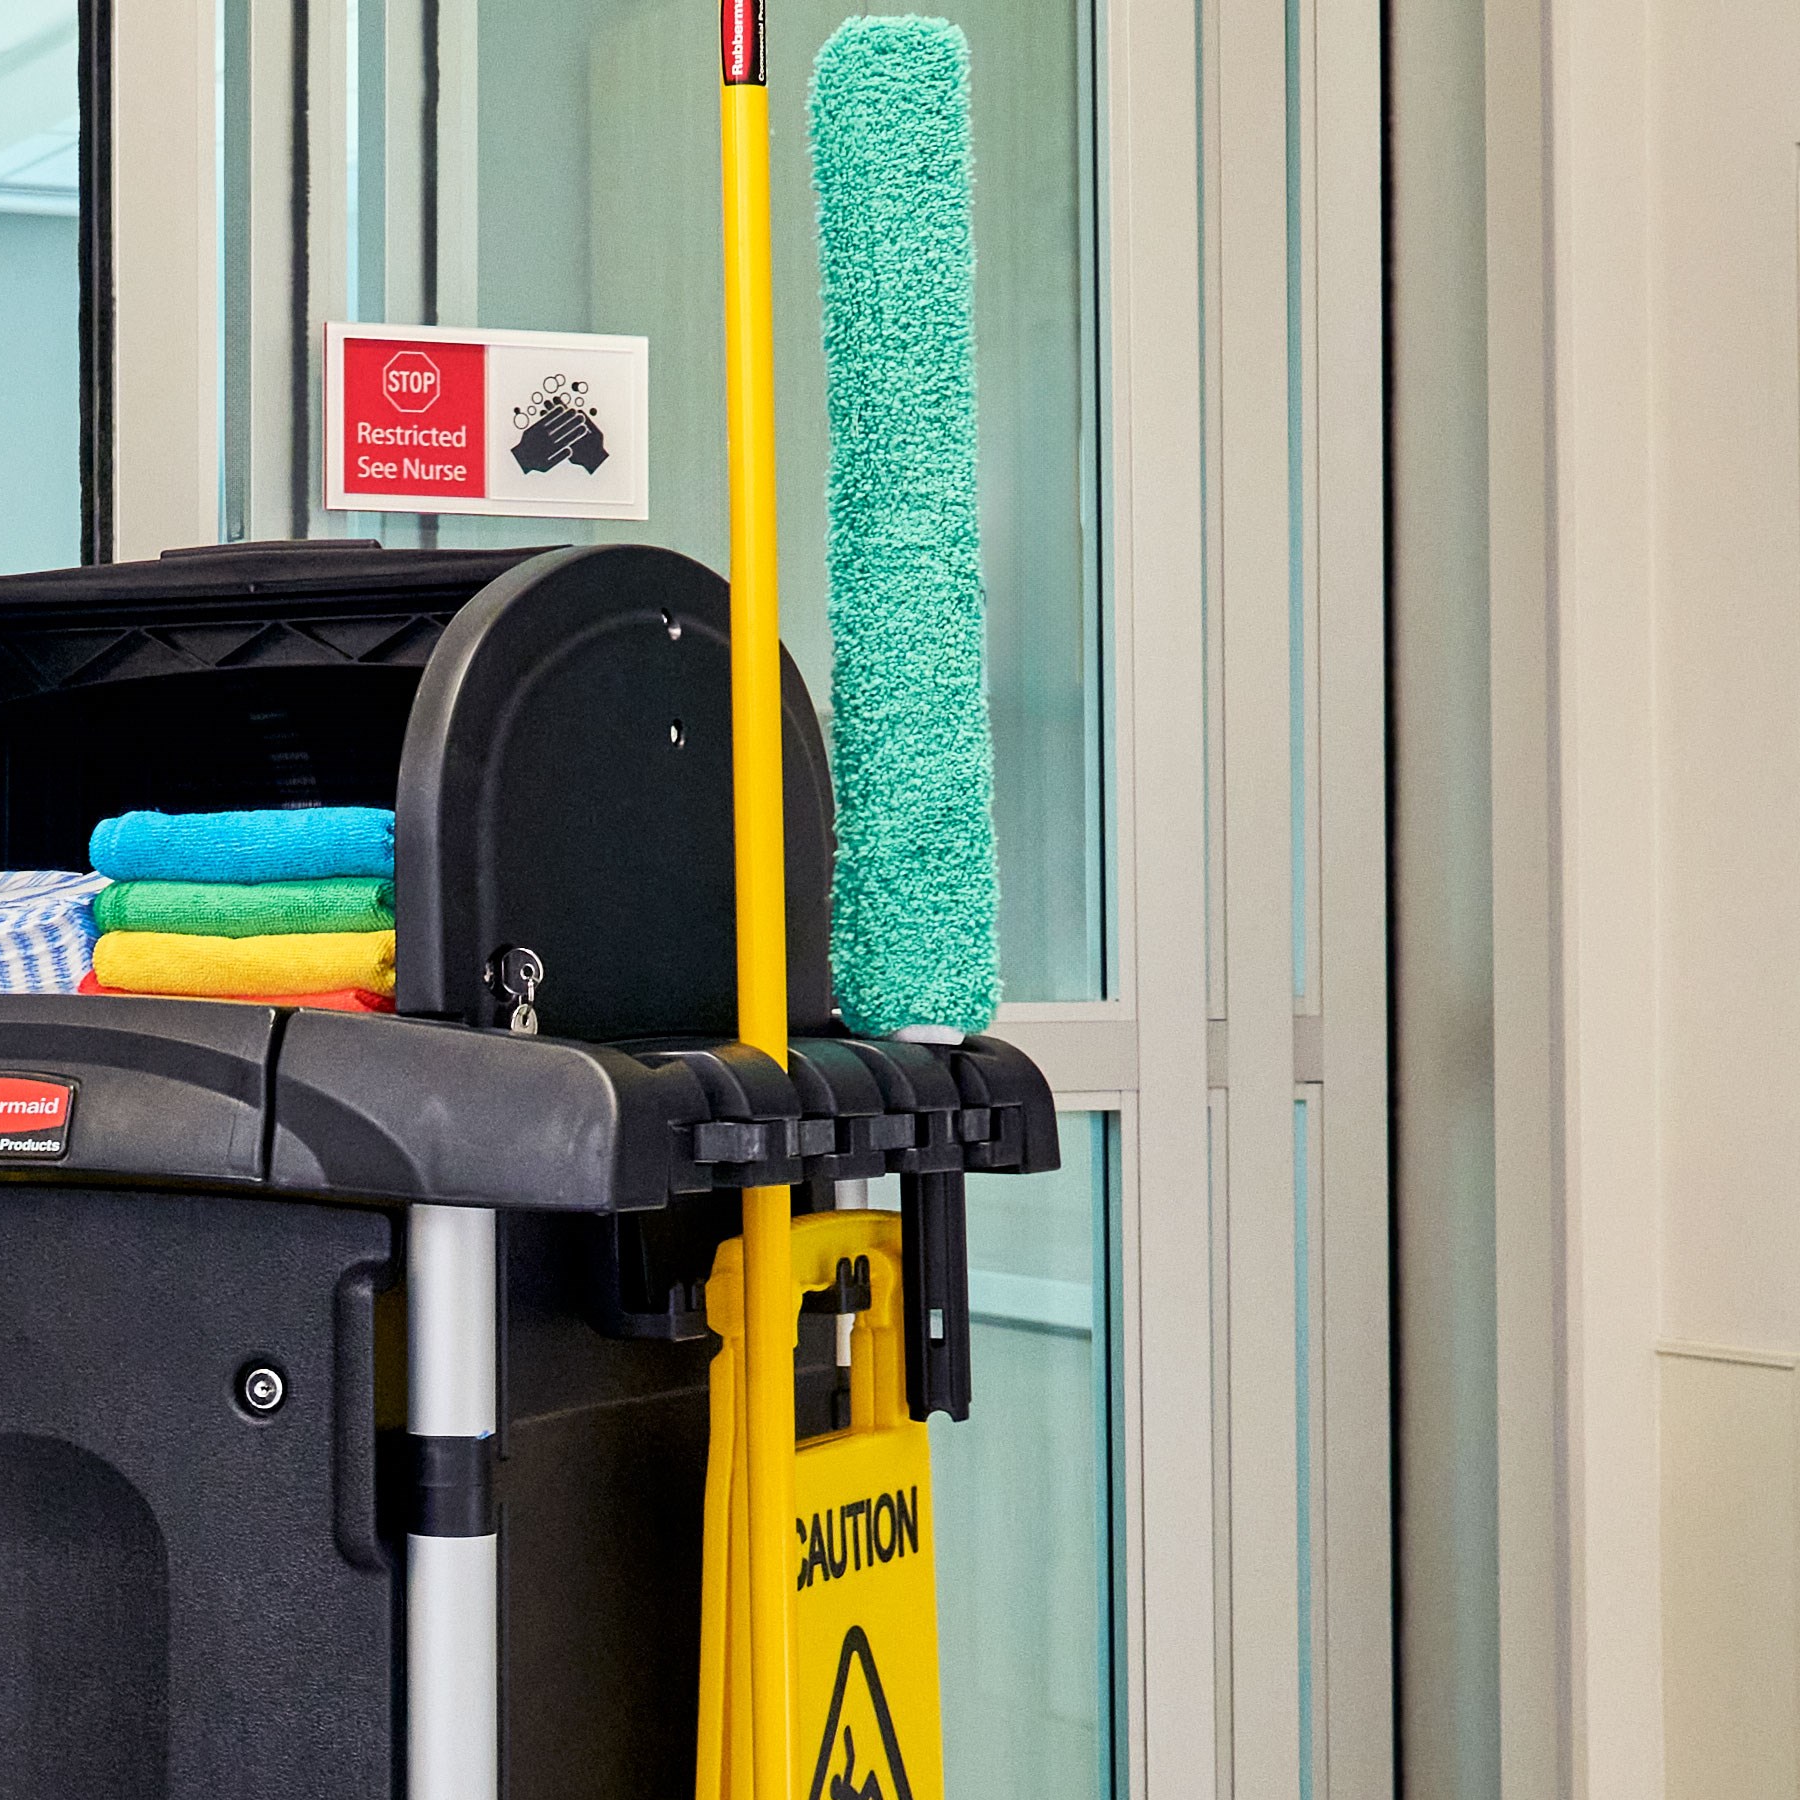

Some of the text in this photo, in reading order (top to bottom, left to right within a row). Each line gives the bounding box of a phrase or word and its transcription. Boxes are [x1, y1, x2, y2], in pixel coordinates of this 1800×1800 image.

[388, 370, 435, 393] STOP
[357, 422, 466, 447] Restricted
[357, 456, 467, 482] See Nurse
[0, 1138, 60, 1152] Products
